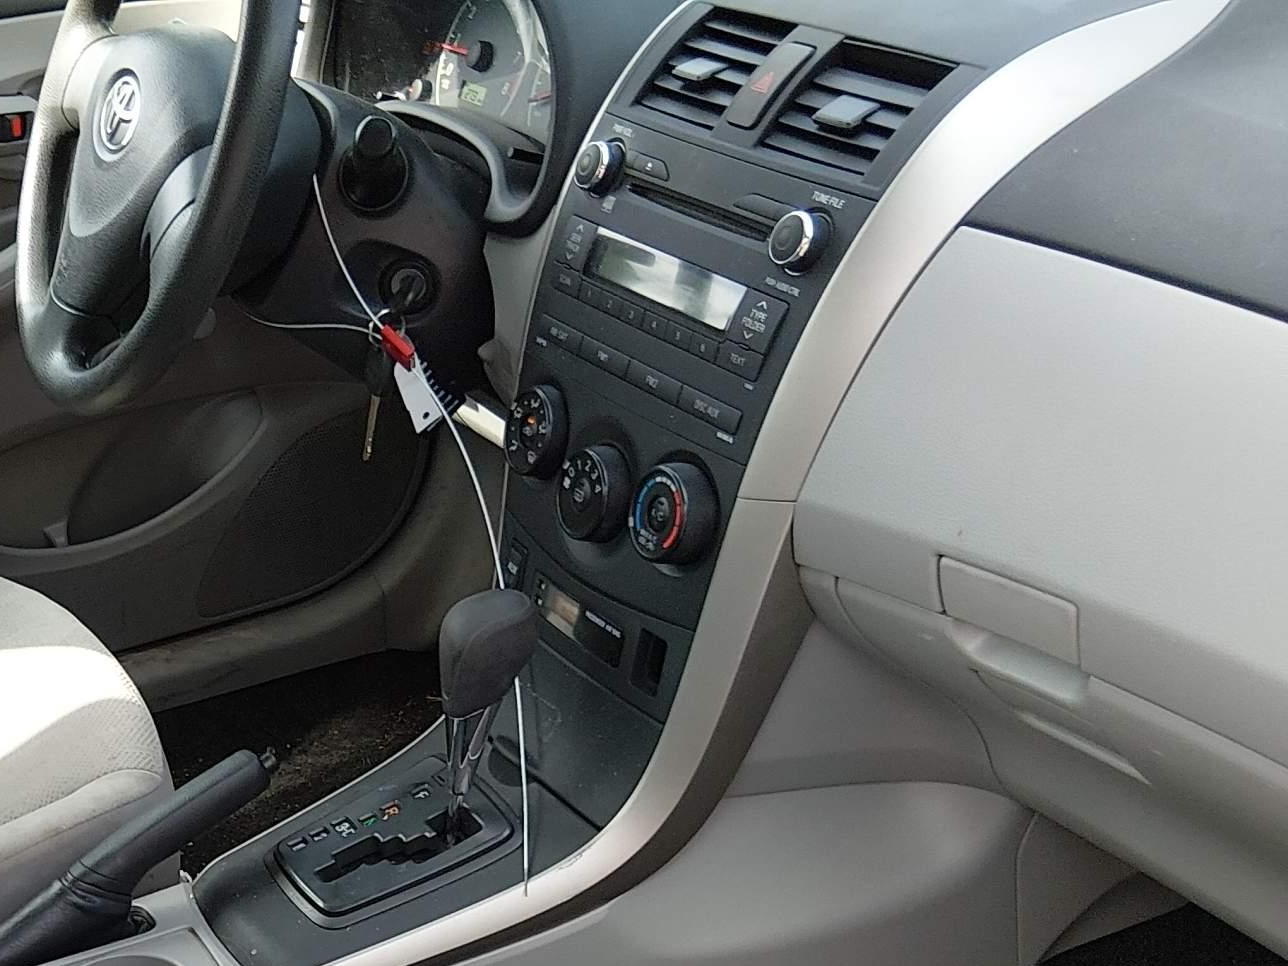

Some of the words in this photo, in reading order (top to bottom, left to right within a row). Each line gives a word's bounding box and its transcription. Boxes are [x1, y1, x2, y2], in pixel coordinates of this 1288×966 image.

[750, 309, 768, 323] TYPE
[742, 316, 766, 334] FOLDER
[730, 352, 746, 367] TEXT
[568, 466, 576, 478] 0
[585, 459, 592, 472] 2
[591, 469, 599, 480] 3
[594, 484, 602, 494] 4
